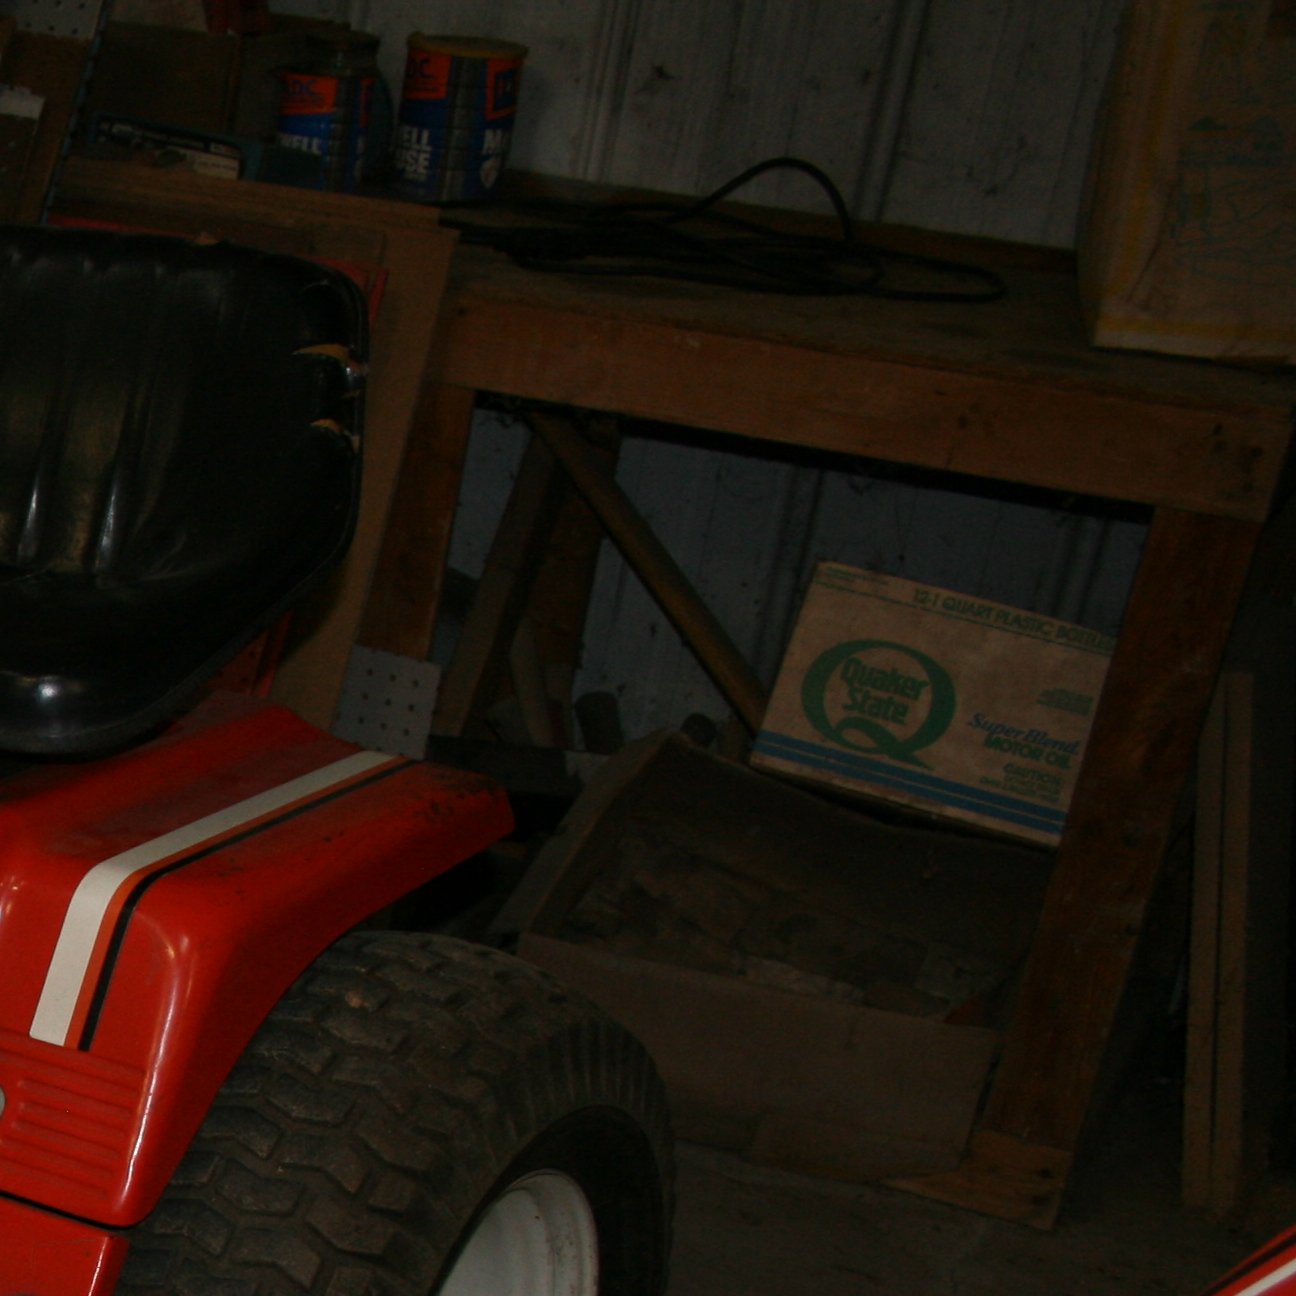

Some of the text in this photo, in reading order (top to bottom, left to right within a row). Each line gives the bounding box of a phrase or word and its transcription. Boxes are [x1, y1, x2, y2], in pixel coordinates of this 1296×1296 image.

[941, 594, 995, 622] QUART
[995, 608, 1055, 637] PLASTIC
[840, 655, 930, 699] Quaker
[842, 685, 911, 726] State
[968, 711, 1081, 755] Super Blend
[983, 733, 1072, 770] MOTOR OIL
